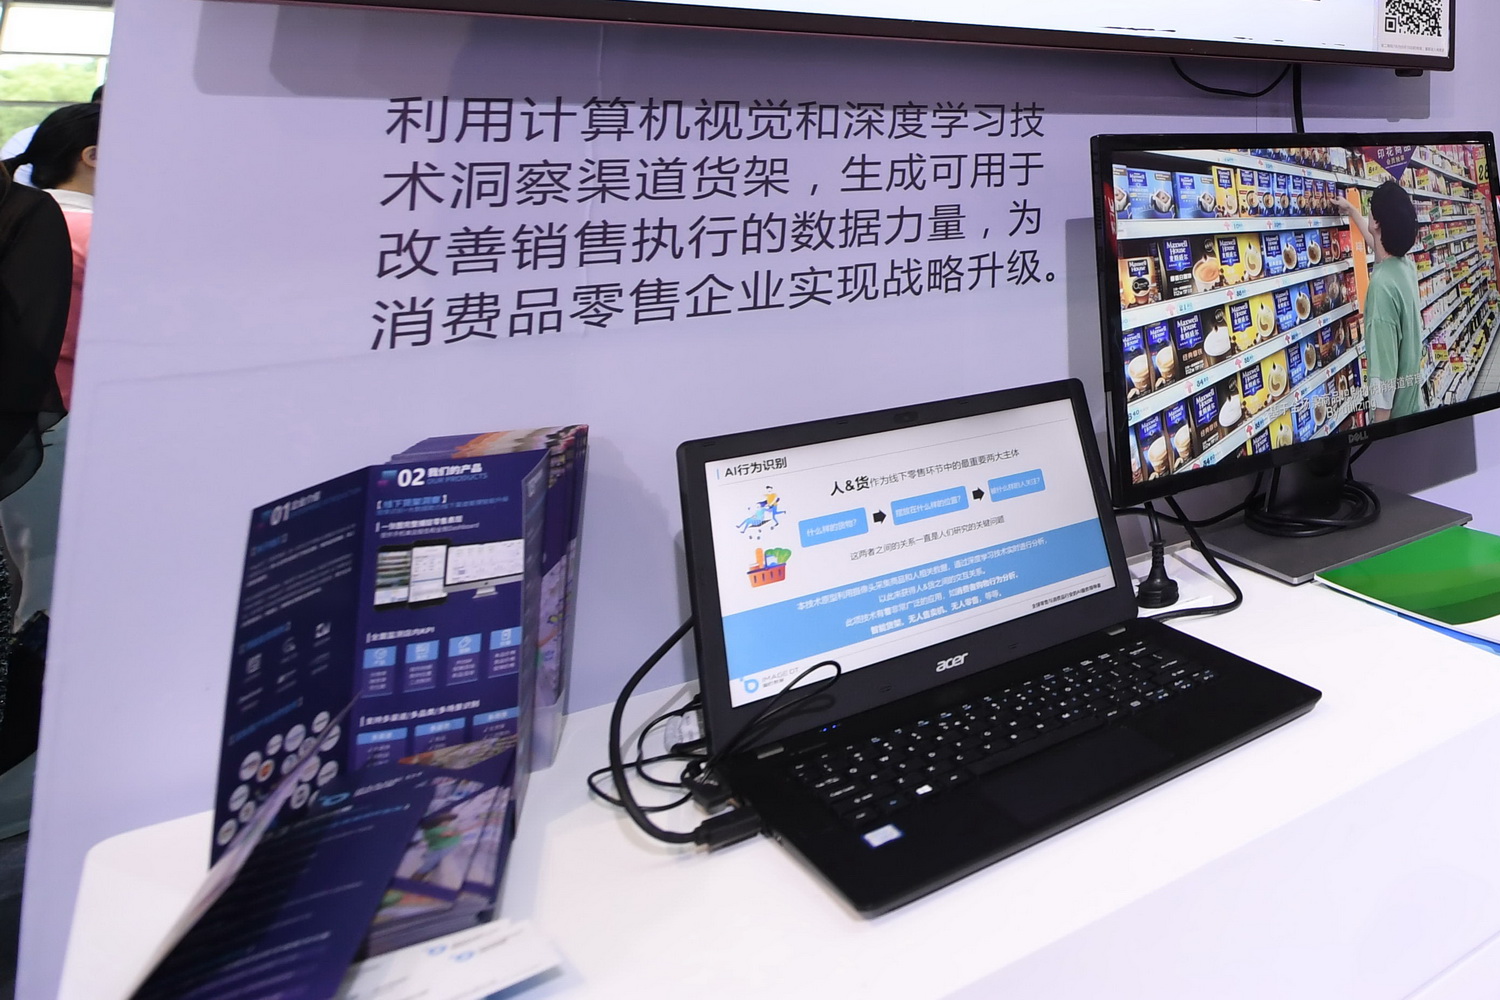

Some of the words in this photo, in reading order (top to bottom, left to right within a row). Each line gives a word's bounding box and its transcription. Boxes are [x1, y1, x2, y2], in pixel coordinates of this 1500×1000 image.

[384, 96, 1046, 145] 利用计算机视觉和深度学习技
[380, 152, 1046, 212] 术洞察渠道货架，生成可用于
[375, 199, 1043, 282] 改善销售执行的数据力量，为
[370, 250, 1056, 351] 消费品零售企业实现战略升级。
[1348, 430, 1369, 443] DELL
[397, 468, 425, 487] 02
[724, 456, 788, 478] AI行为识别
[270, 501, 291, 526] 01
[935, 652, 969, 673] acer
